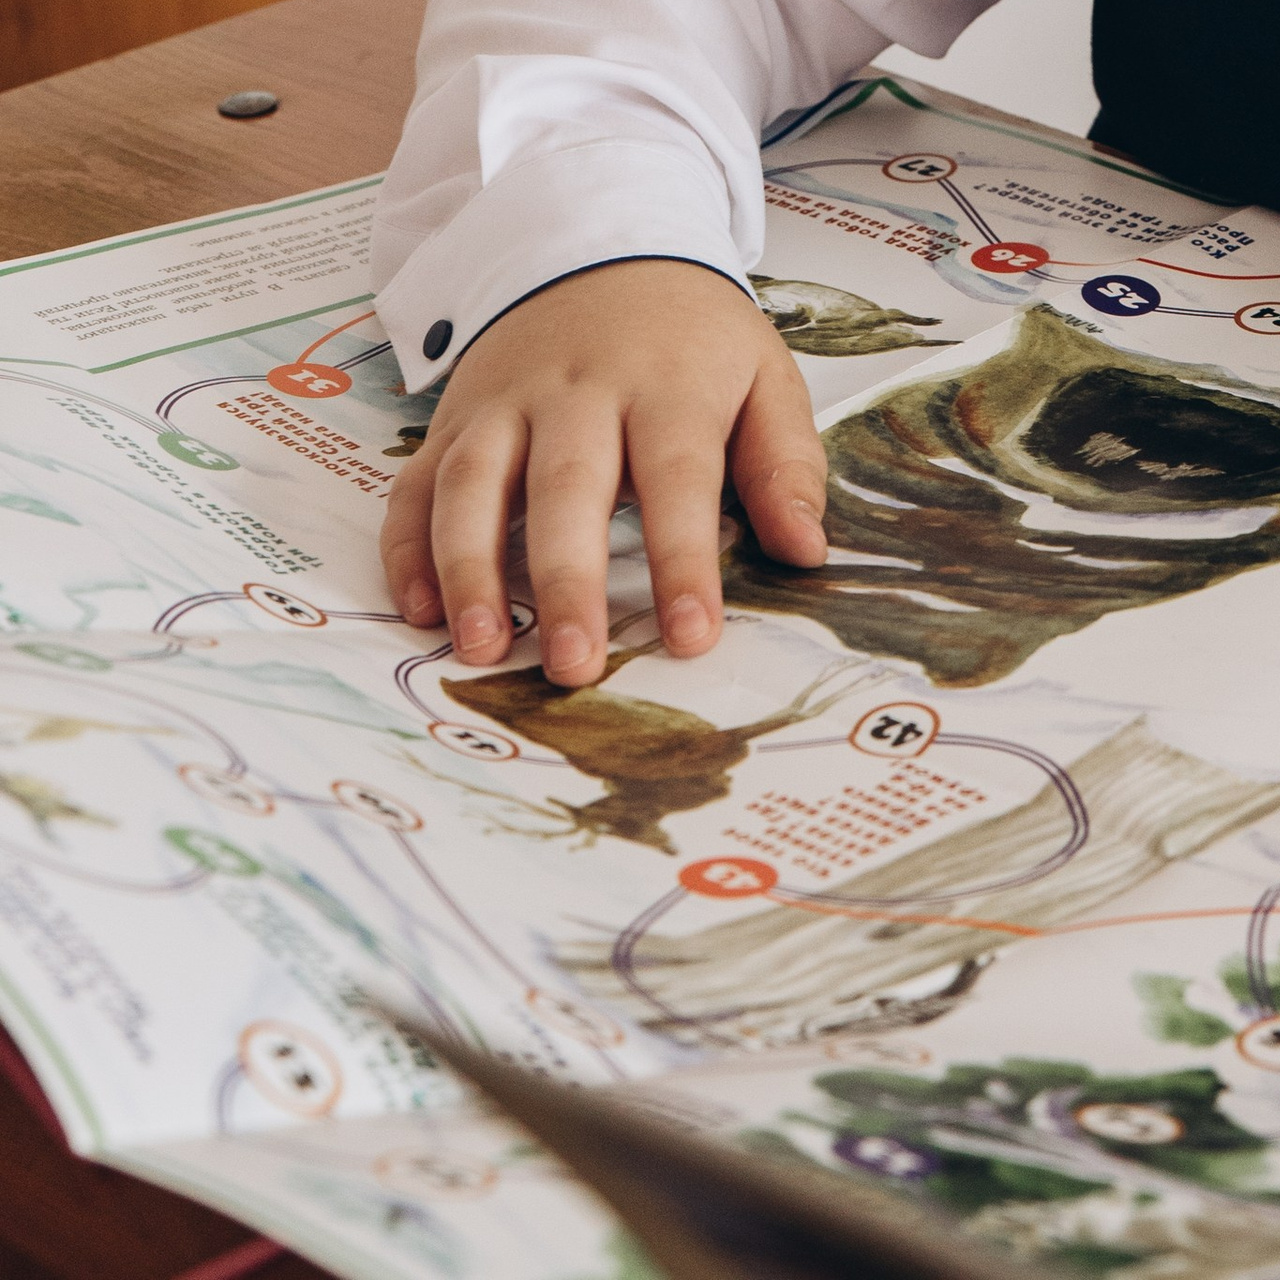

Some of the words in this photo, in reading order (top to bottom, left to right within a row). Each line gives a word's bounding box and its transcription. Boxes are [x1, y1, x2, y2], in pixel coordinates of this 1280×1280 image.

[898, 159, 945, 177] 27
[764, 195, 821, 219] трещи
[813, 202, 836, 212] на
[824, 217, 880, 240] тобой
[838, 209, 890, 230] назад
[1058, 212, 1104, 228] этой
[1128, 212, 1163, 227] три
[906, 223, 972, 248] ходов!
[884, 237, 942, 262] Перед
[991, 248, 1038, 267] 26
[1191, 239, 1227, 259] Кто
[112, 269, 211, 297] внимательно
[202, 271, 242, 286] даже
[267, 283, 283, 292] В
[33, 293, 109, 318] прочитай
[117, 282, 200, 308] опасности!
[219, 289, 259, 303] пути
[1097, 281, 1149, 309] 25
[59, 304, 158, 332] знакомства,
[73, 304, 117, 320] Если
[175, 301, 213, 314] тебя
[46, 316, 72, 326] ты
[75, 312, 167, 341] поджидают
[286, 369, 340, 393] 31
[233, 396, 270, 416] три
[248, 391, 313, 425] назад!
[215, 401, 351, 477] поскользнулся
[271, 417, 339, 456] Сделай
[314, 425, 361, 451] шага
[178, 440, 230, 466] 32
[337, 456, 395, 482] упал!
[350, 477, 378, 493] Ты
[207, 503, 307, 572] Затормози
[229, 511, 287, 546] хода!
[222, 529, 289, 576] Горная
[287, 549, 324, 569] три
[870, 715, 924, 748] 42
